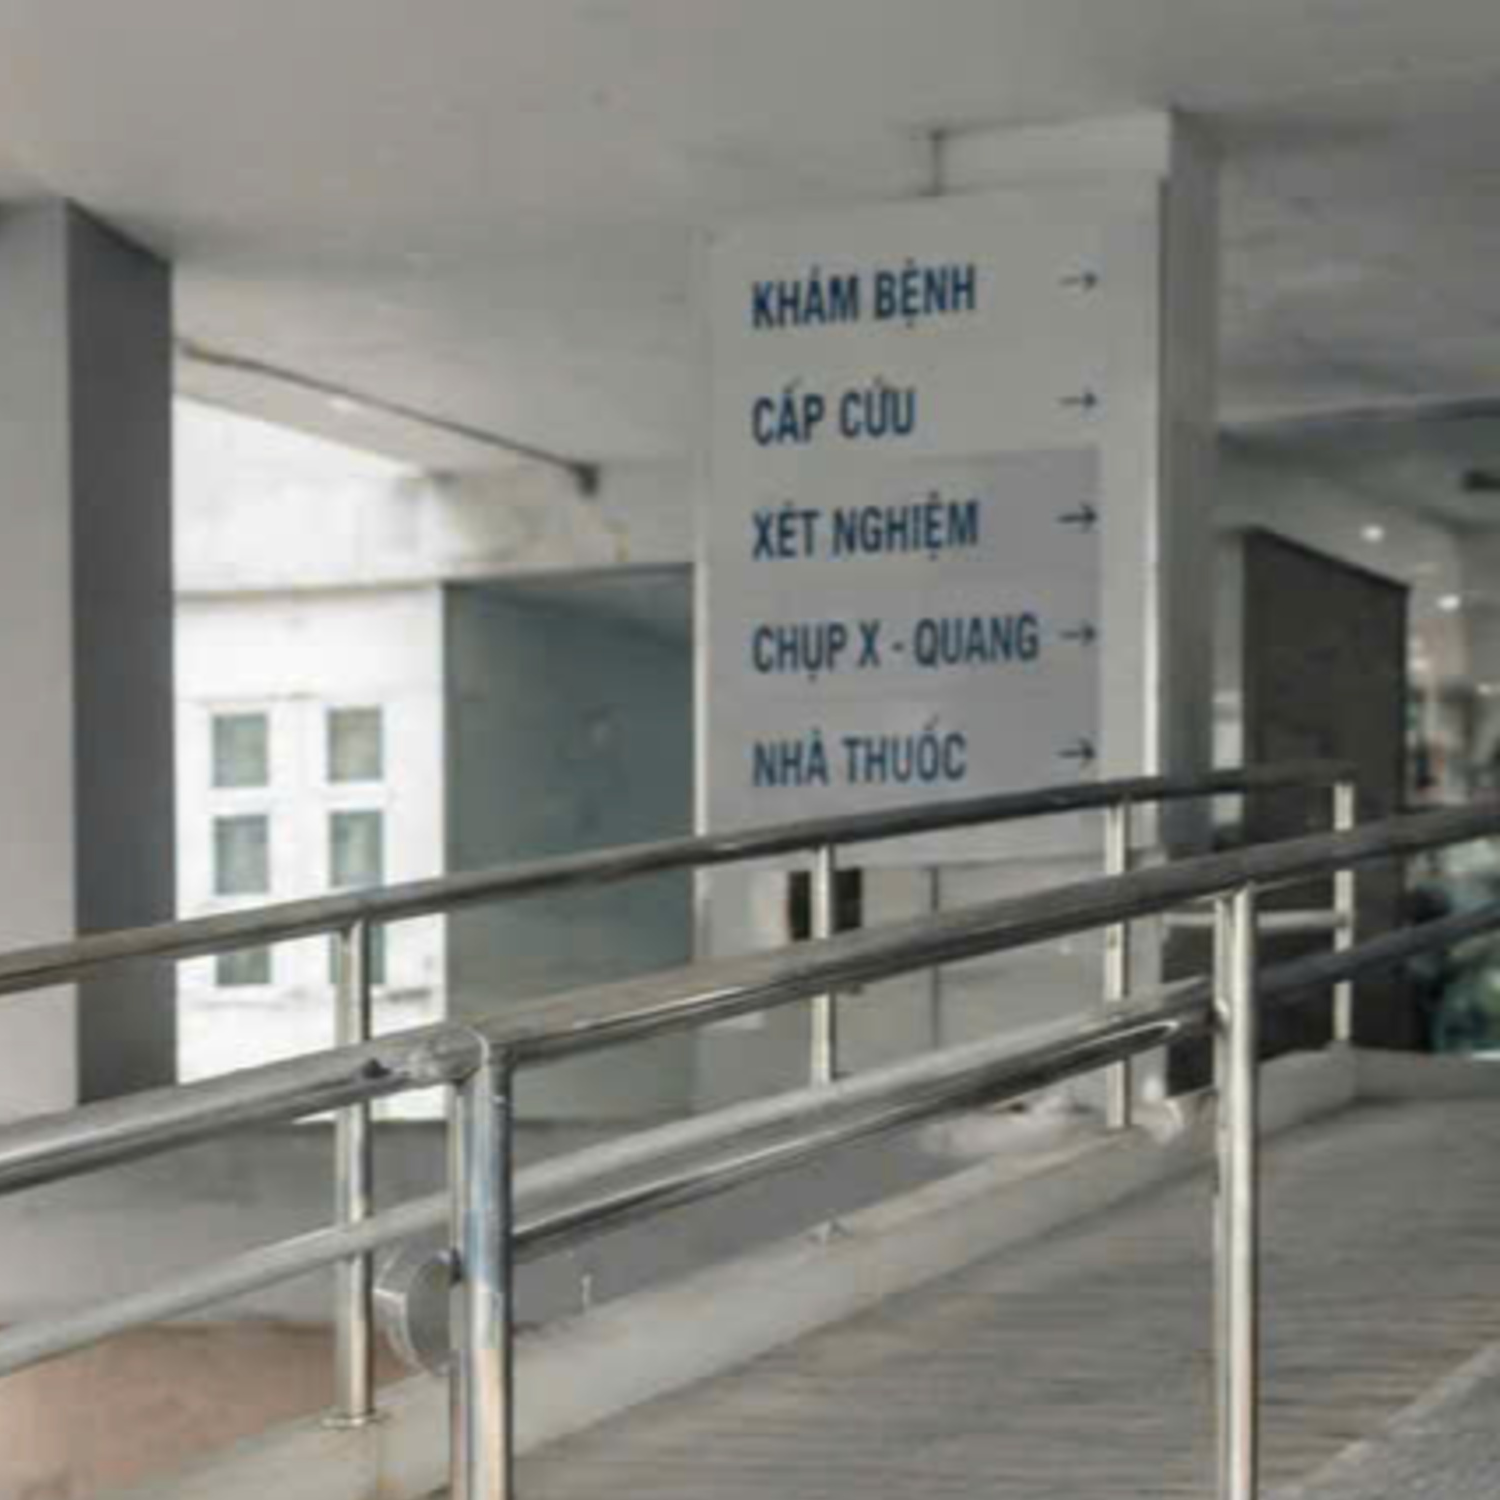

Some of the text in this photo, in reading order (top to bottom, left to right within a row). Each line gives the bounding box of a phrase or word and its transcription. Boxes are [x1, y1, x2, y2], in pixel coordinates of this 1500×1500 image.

[751, 258, 976, 330] KHÁM BỆNH
[751, 376, 917, 446] CẤP CỨU
[752, 490, 979, 561] XÉT NGHIỆM
[752, 622, 847, 683] CHỤP
[859, 620, 881, 668] X
[914, 612, 1040, 669] QUANG
[752, 714, 968, 787] NHÀ THUỐC
